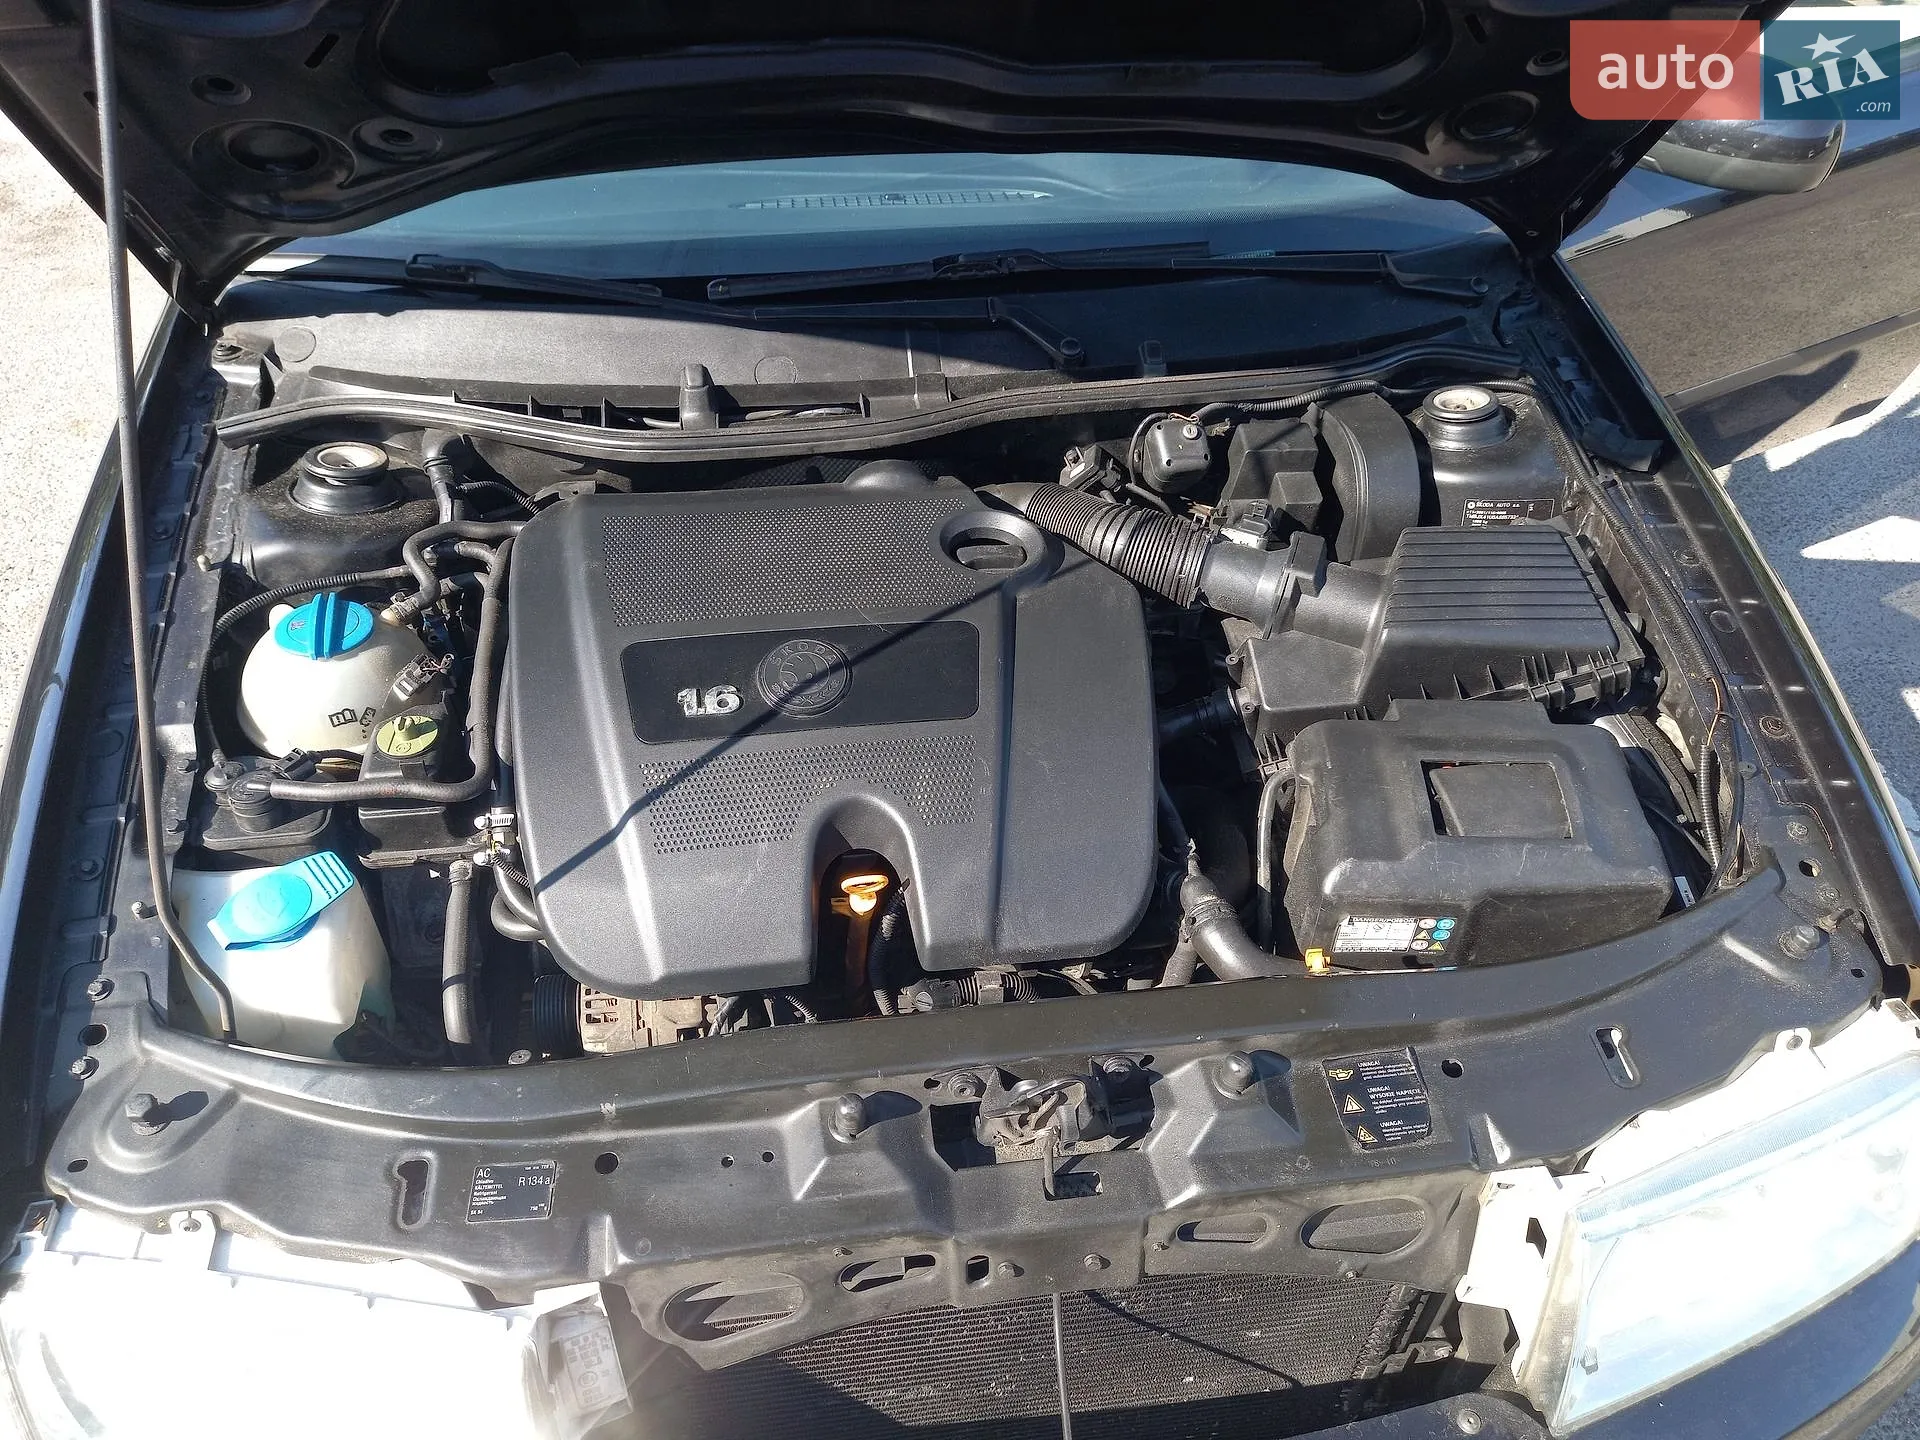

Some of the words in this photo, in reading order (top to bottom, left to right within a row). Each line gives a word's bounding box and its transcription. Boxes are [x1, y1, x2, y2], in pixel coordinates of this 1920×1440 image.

[677, 684, 740, 717] 1.6
[1357, 1060, 1380, 1068] UWAGA!
[1367, 1085, 1390, 1093] UWAGA!
[1369, 1091, 1396, 1100] WYSOKIE
[1379, 1119, 1404, 1128] UWAGA!
[476, 1168, 491, 1179] AC
